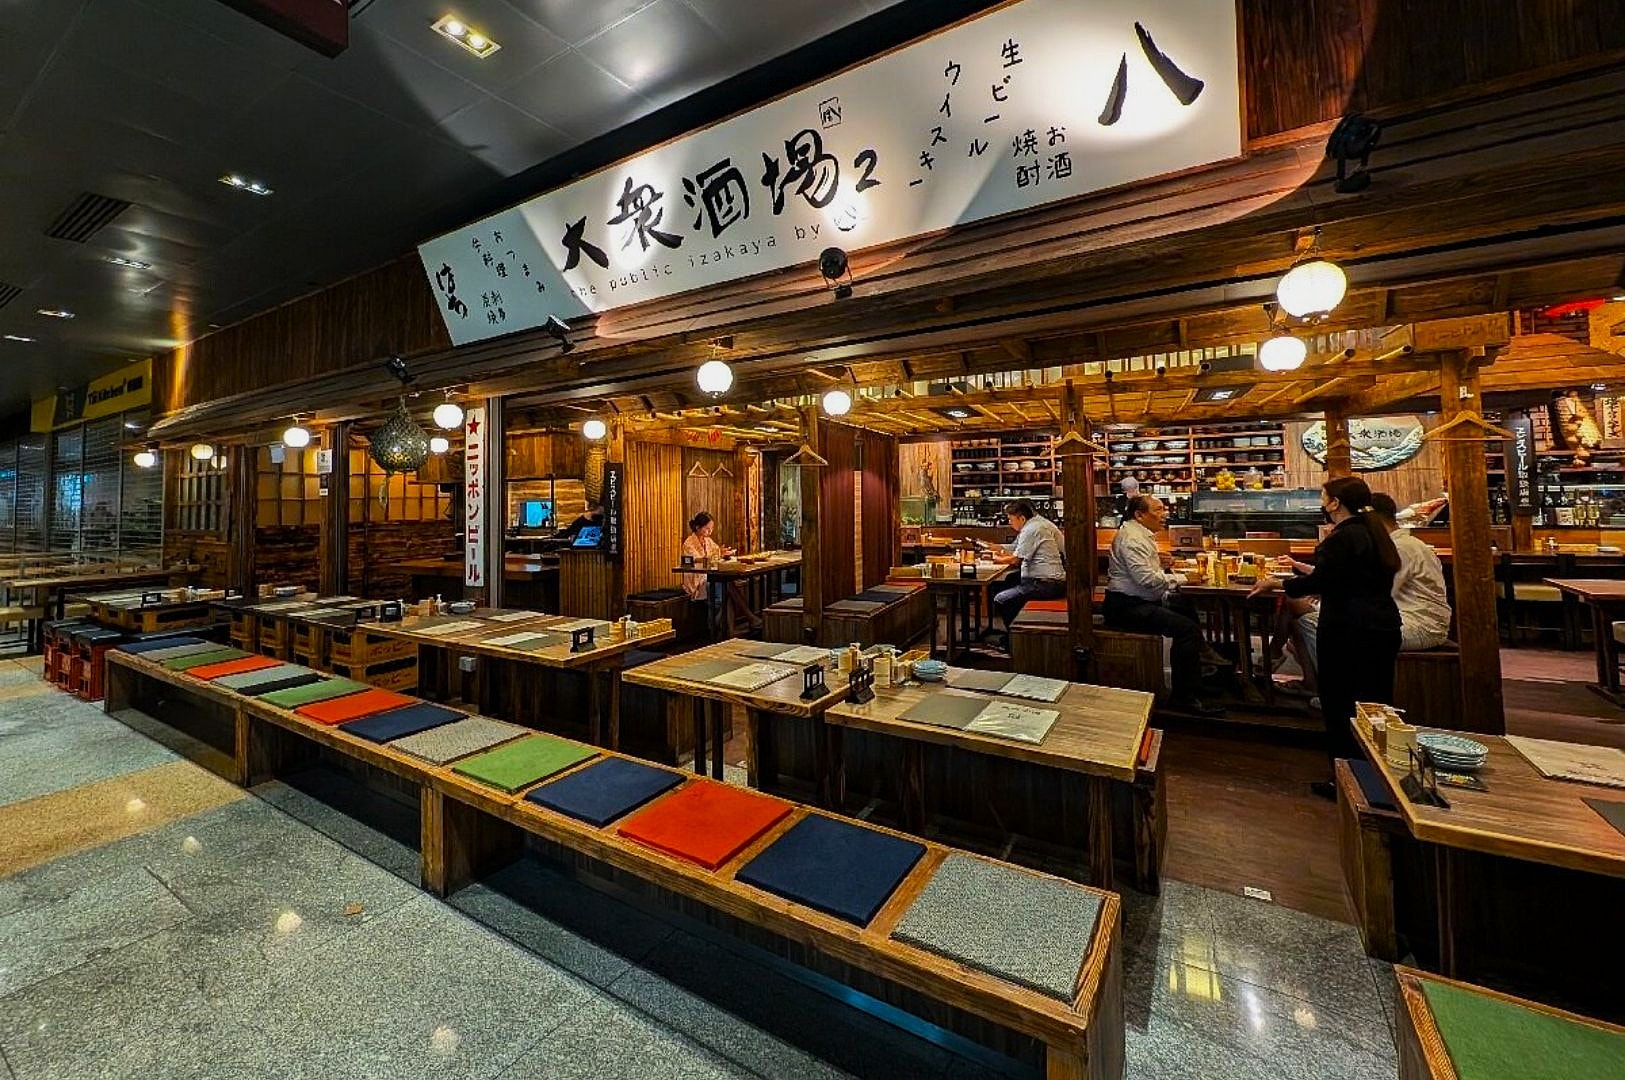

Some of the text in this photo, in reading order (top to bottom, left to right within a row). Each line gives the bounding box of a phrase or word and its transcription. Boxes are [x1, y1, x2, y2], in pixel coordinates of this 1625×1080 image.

[909, 61, 961, 188] ウイスキー
[968, 38, 1023, 157] 生ビール
[1098, 21, 1205, 126] 八
[1012, 129, 1041, 189] 焼酎
[1046, 126, 1073, 180] お酒
[609, 264, 673, 292] public
[687, 236, 777, 267] izakaya
[794, 223, 820, 240] by
[466, 443, 480, 583] ニッポンビール
